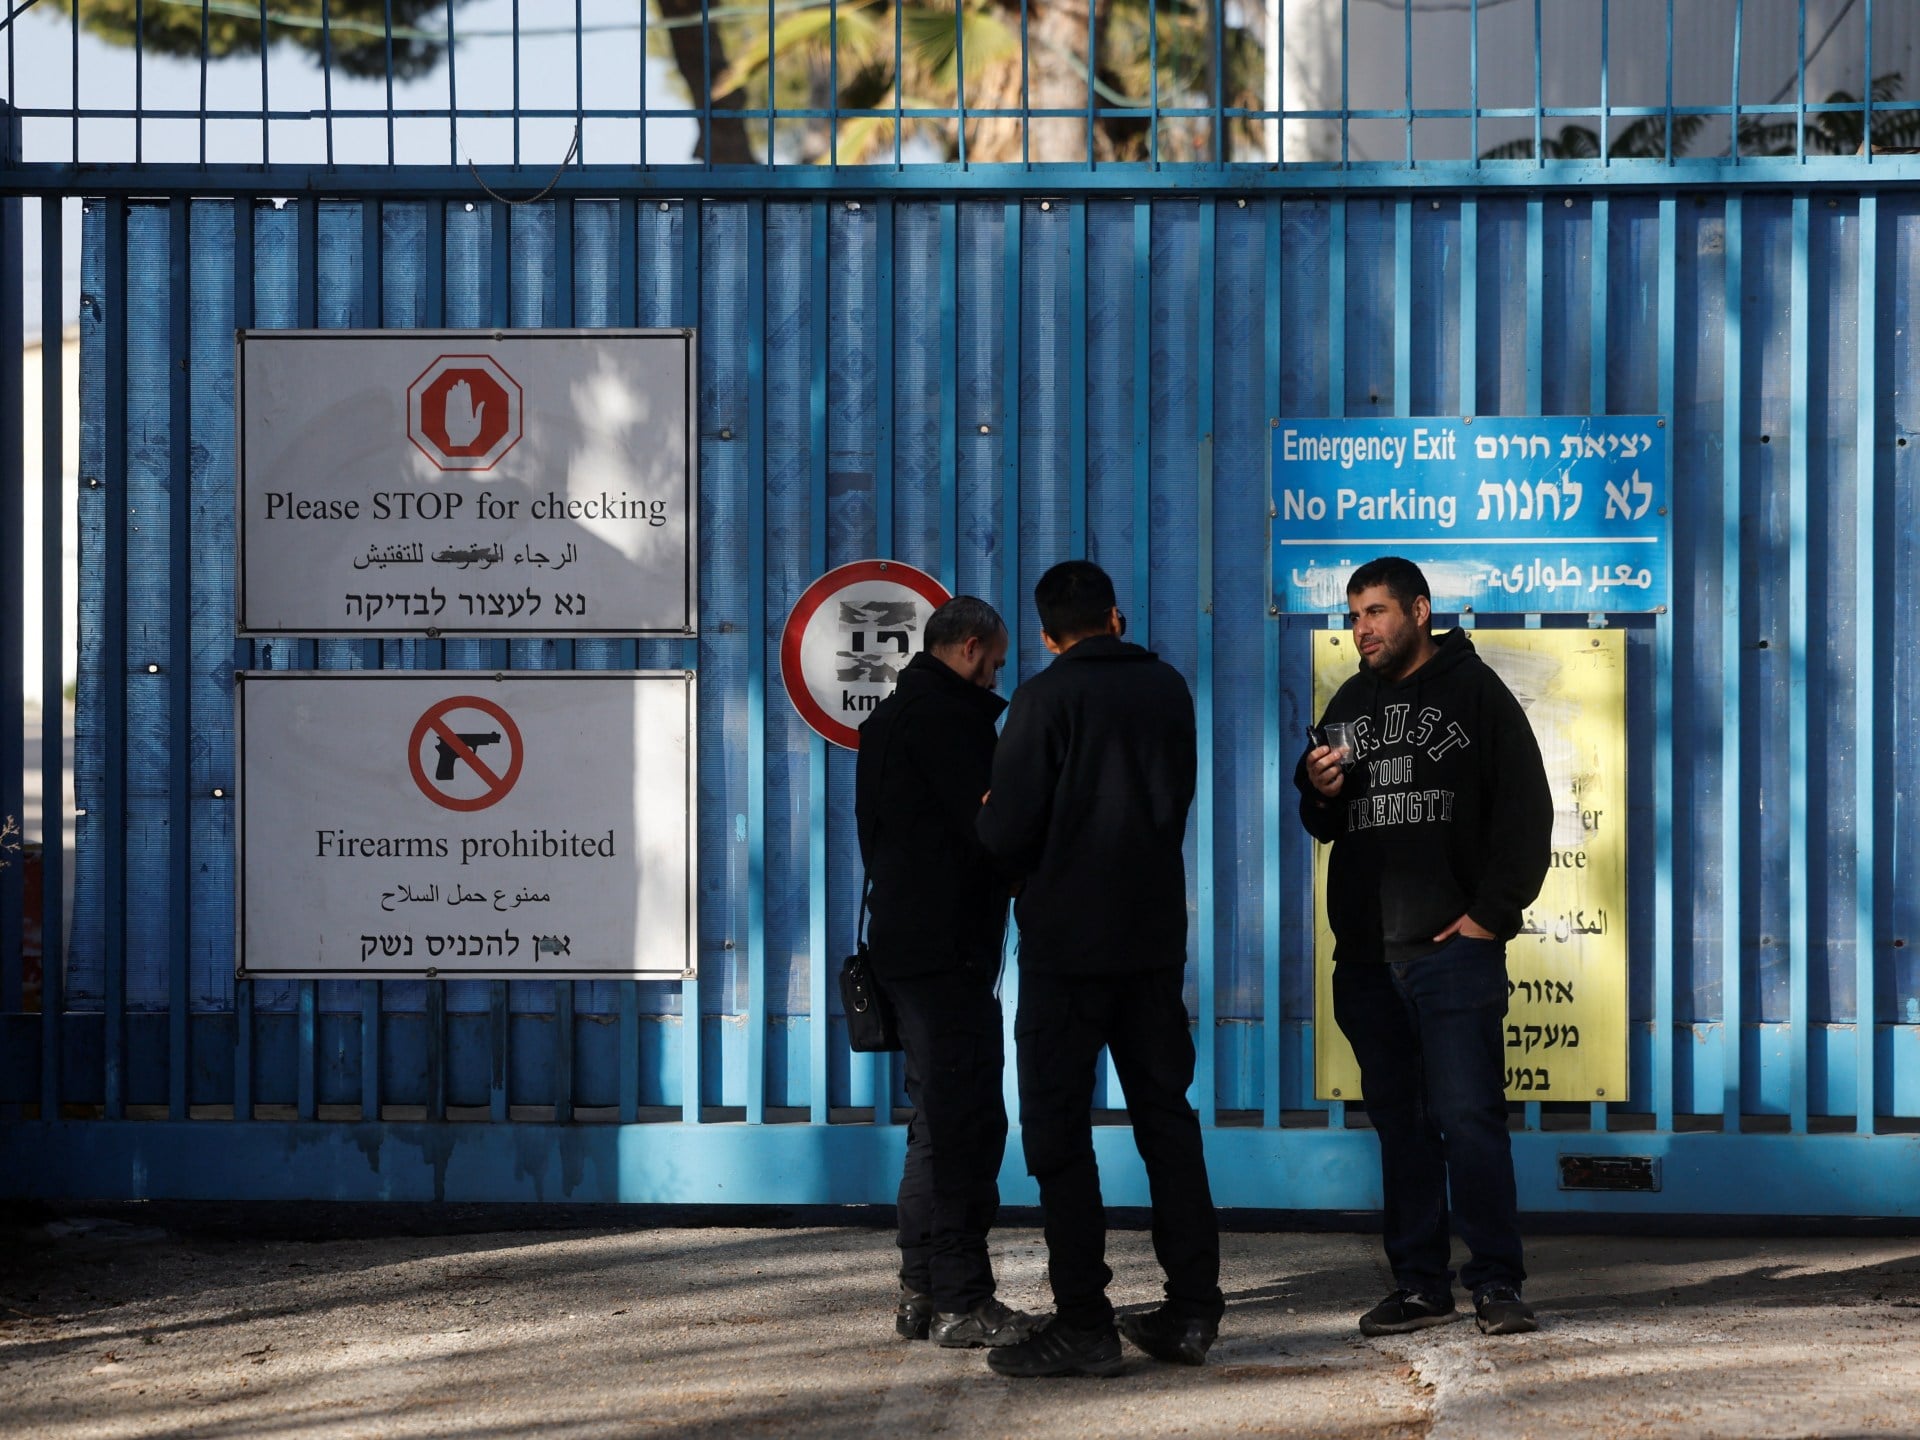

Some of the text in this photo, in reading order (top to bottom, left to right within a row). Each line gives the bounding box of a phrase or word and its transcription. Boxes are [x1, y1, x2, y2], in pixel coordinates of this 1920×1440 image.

[1283, 428, 1456, 469] Emergency Exit
[1474, 433, 1652, 460] יציאת חרום
[263, 491, 667, 527] Please STOP for checking
[1283, 488, 1456, 527] No Parking
[1476, 468, 1653, 522] לא לחנות
[353, 543, 424, 570] للتفتيش
[514, 543, 577, 570] الرجاء
[1588, 563, 1652, 593] معبر
[345, 586, 586, 622] נא לעצור לבדיקה
[1346, 703, 1471, 774] RUST
[1368, 755, 1414, 788] YOUR
[1348, 789, 1455, 832] TRENGTH
[315, 829, 617, 865] Firearms prohibited
[381, 883, 550, 911] ممنوع حمل السلاح
[360, 934, 413, 963] נשק
[425, 929, 520, 956] להכניס
[1506, 1023, 1579, 1055] מעקב
